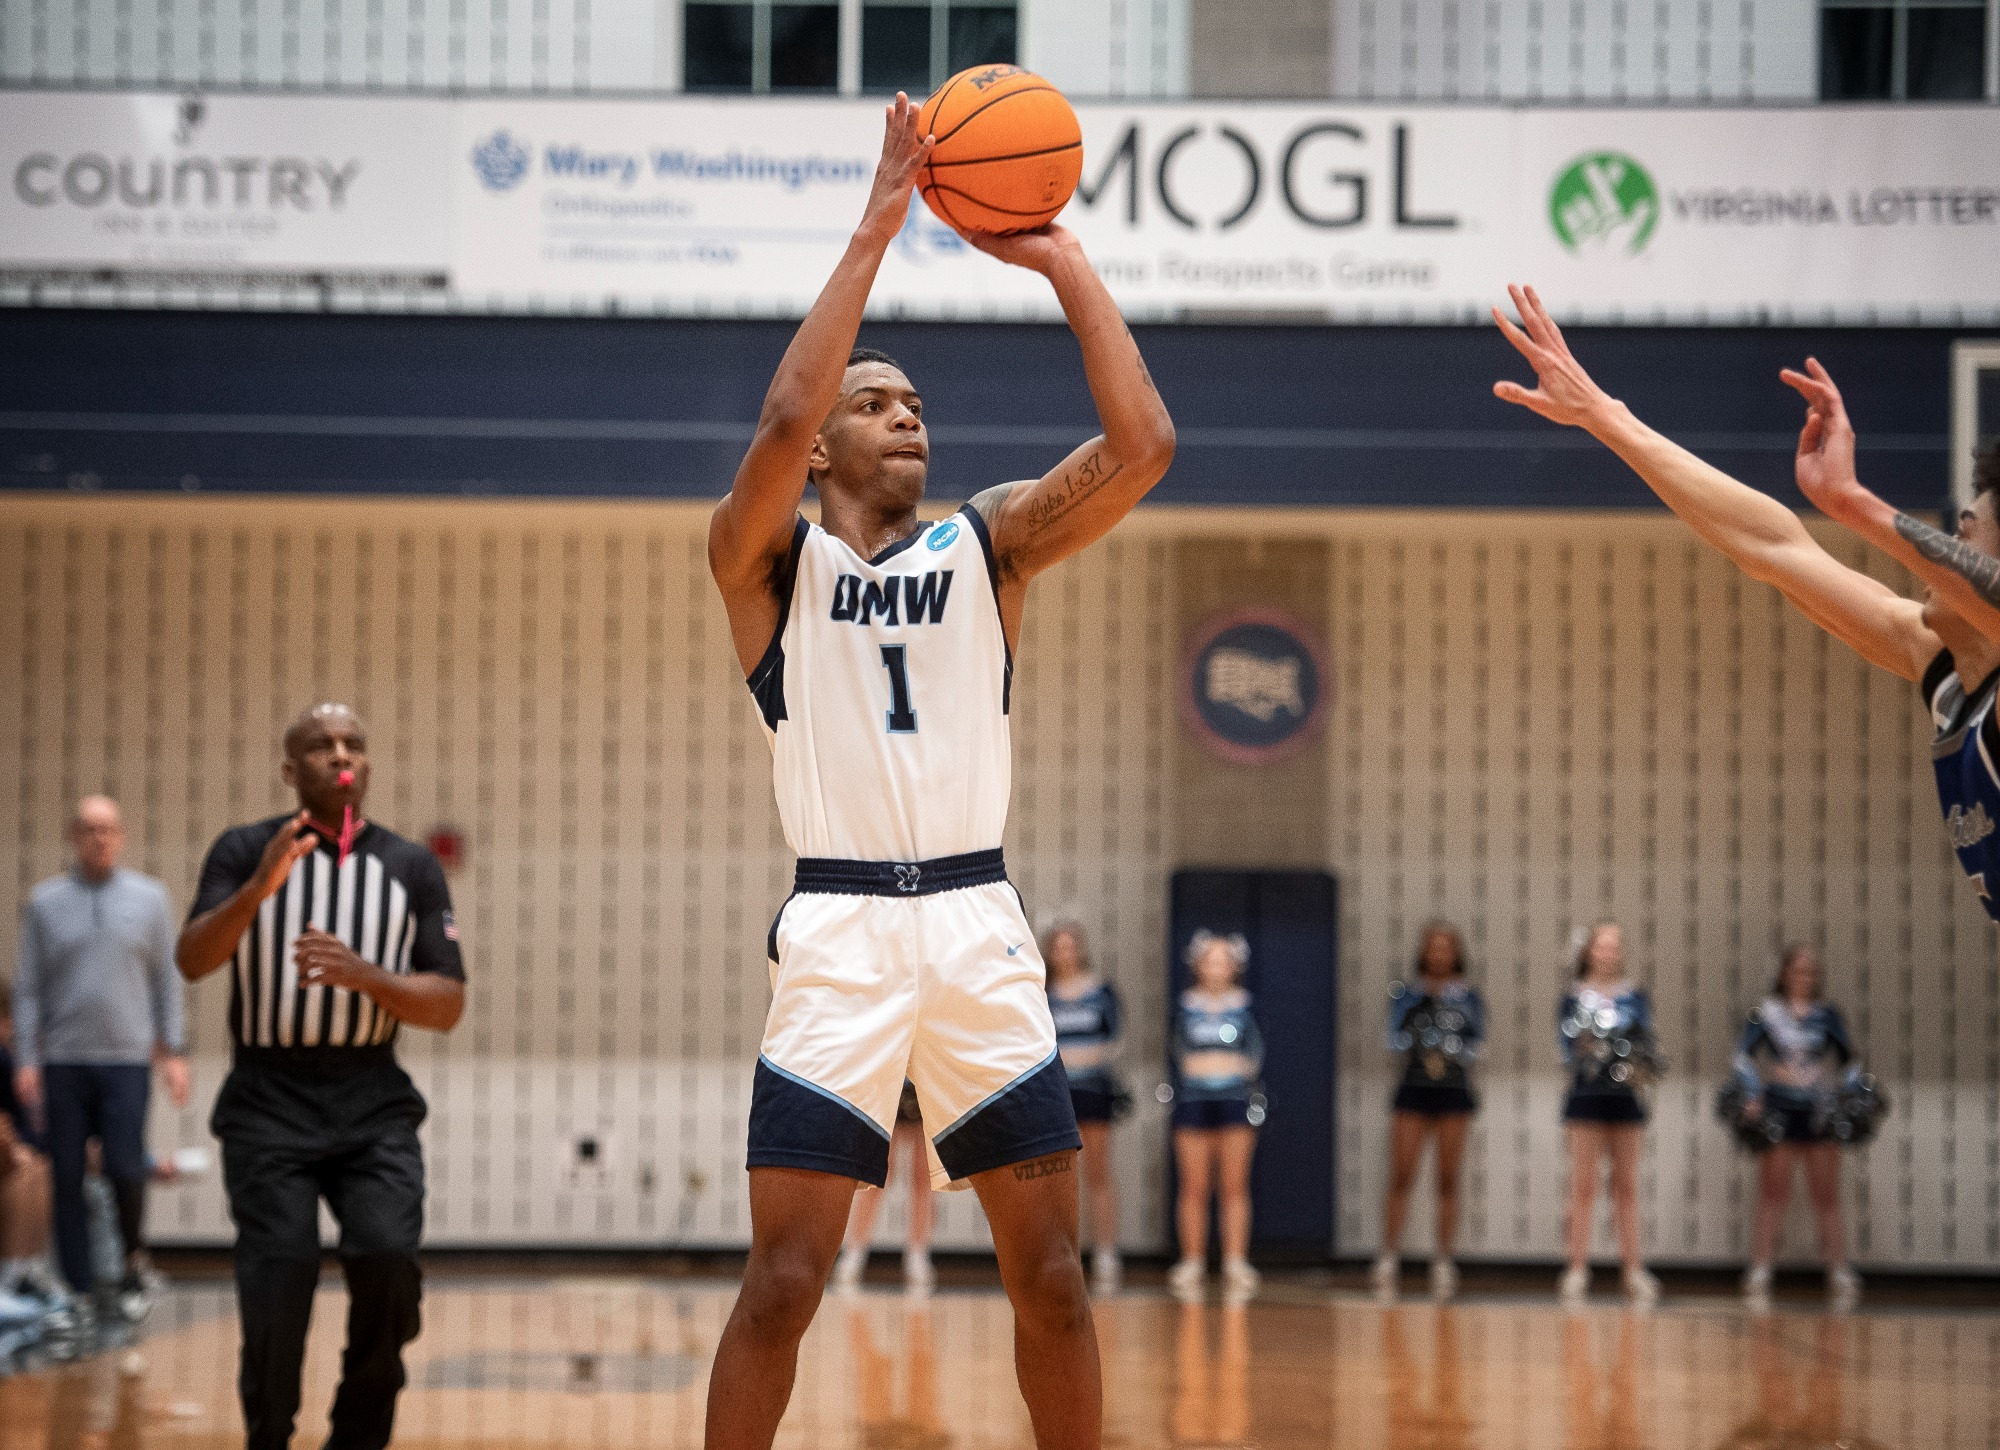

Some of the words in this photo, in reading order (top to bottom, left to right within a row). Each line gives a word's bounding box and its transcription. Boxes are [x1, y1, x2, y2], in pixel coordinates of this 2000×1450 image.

[544, 145, 638, 186] Mary
[651, 147, 871, 190] Washington
[1673, 187, 1839, 226] VIRGINIA
[1850, 188, 2000, 227] LOTTER
[1027, 493, 1066, 528] Luke
[932, 526, 958, 548] NCAA
[878, 643, 918, 734] 1
